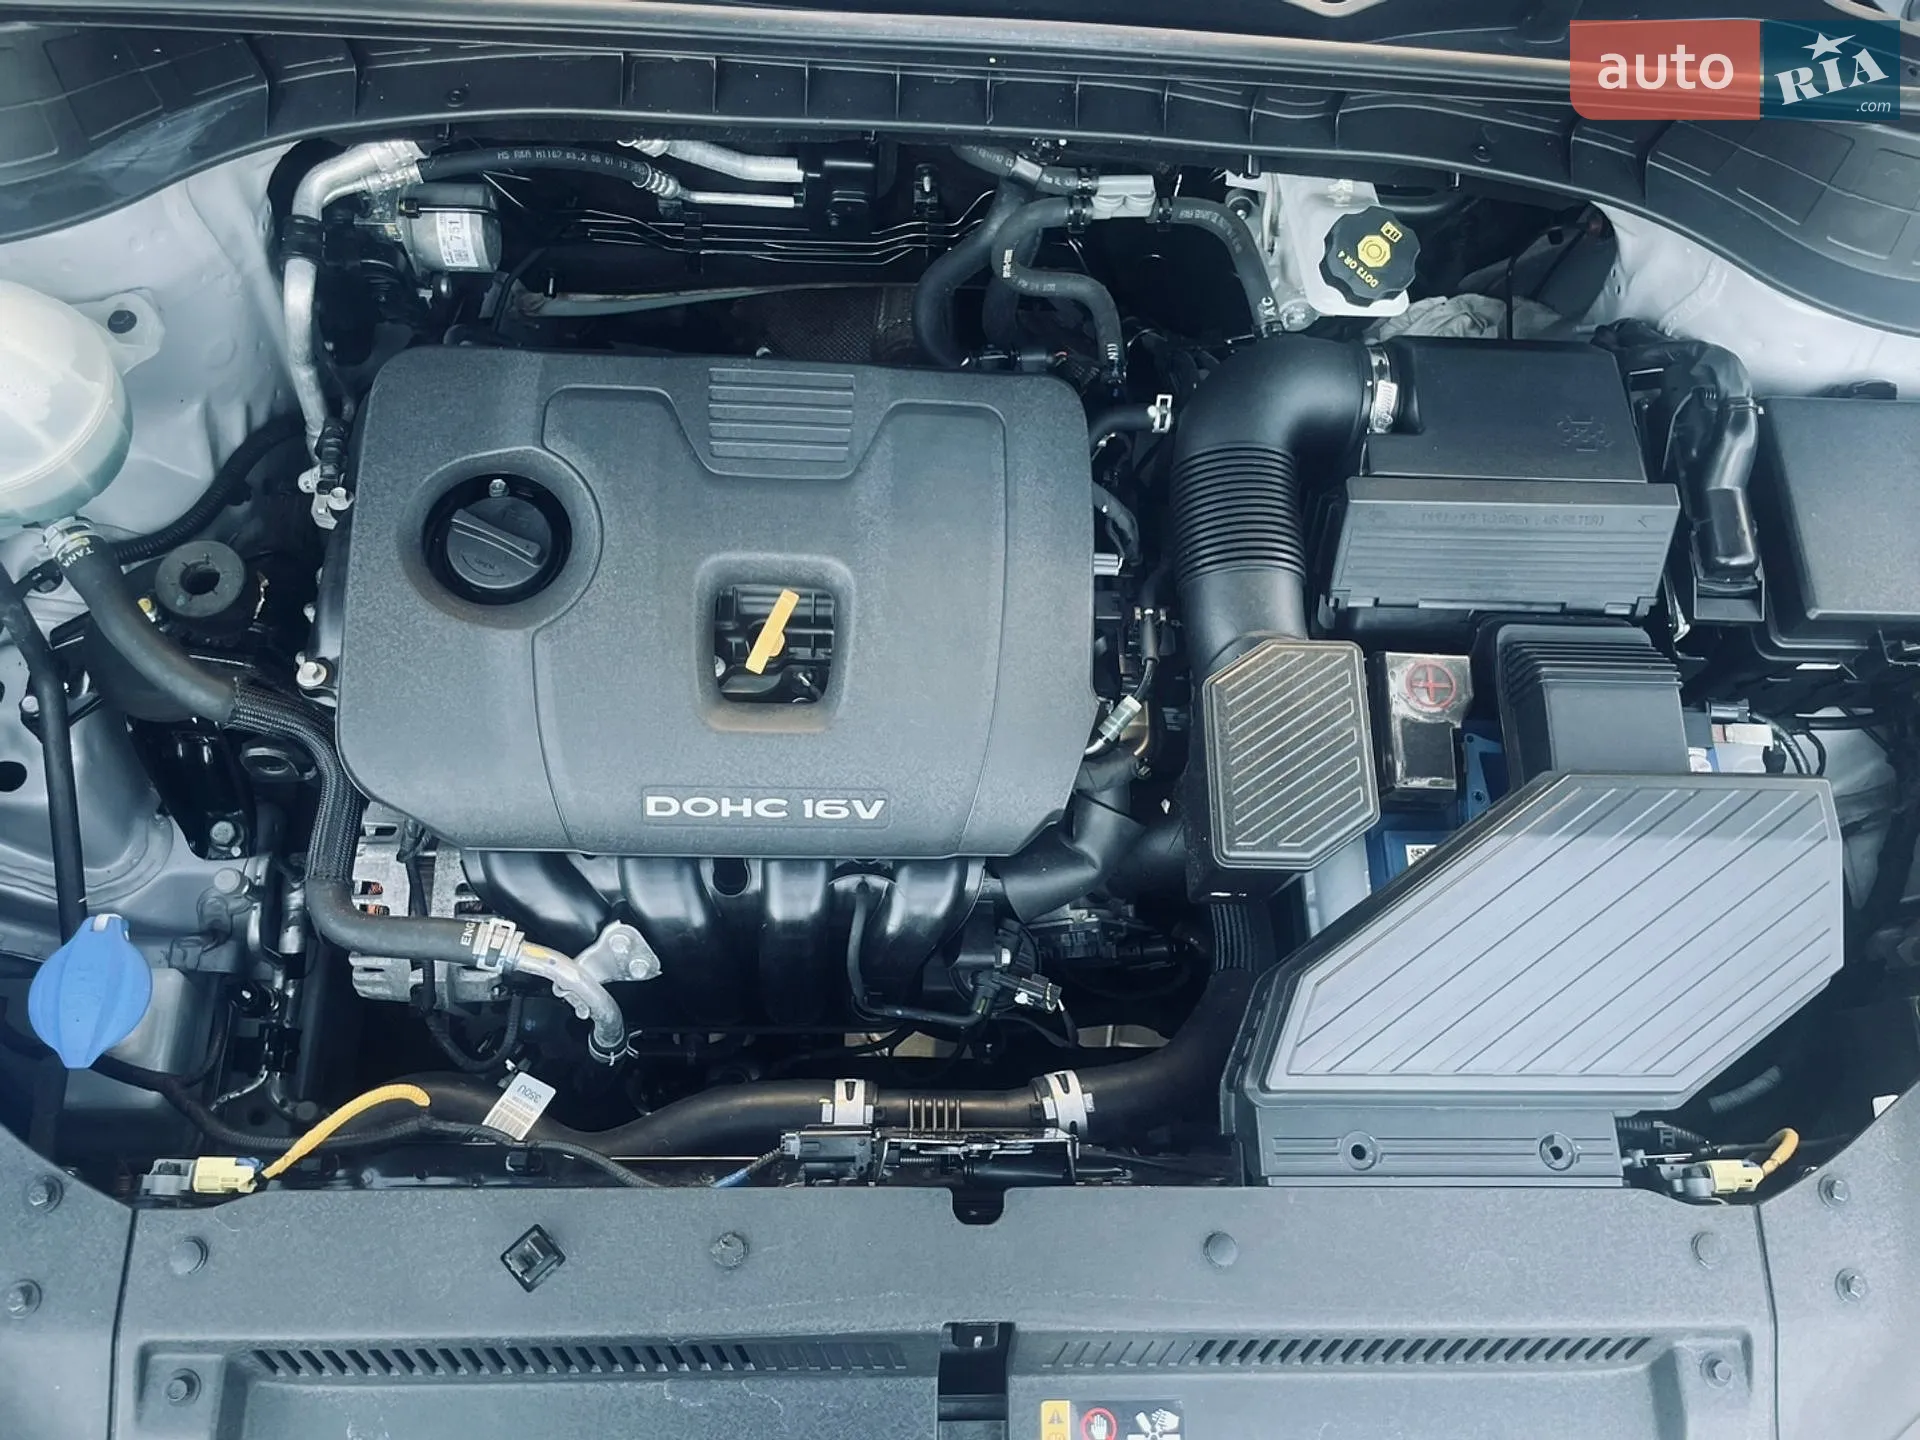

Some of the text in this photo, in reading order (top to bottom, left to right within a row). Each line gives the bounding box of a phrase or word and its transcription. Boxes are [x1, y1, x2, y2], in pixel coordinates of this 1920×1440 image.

[1337, 250, 1379, 288] DOT3 OR 4
[646, 796, 886, 820] DOHC 16V
[460, 922, 476, 946] ENG
